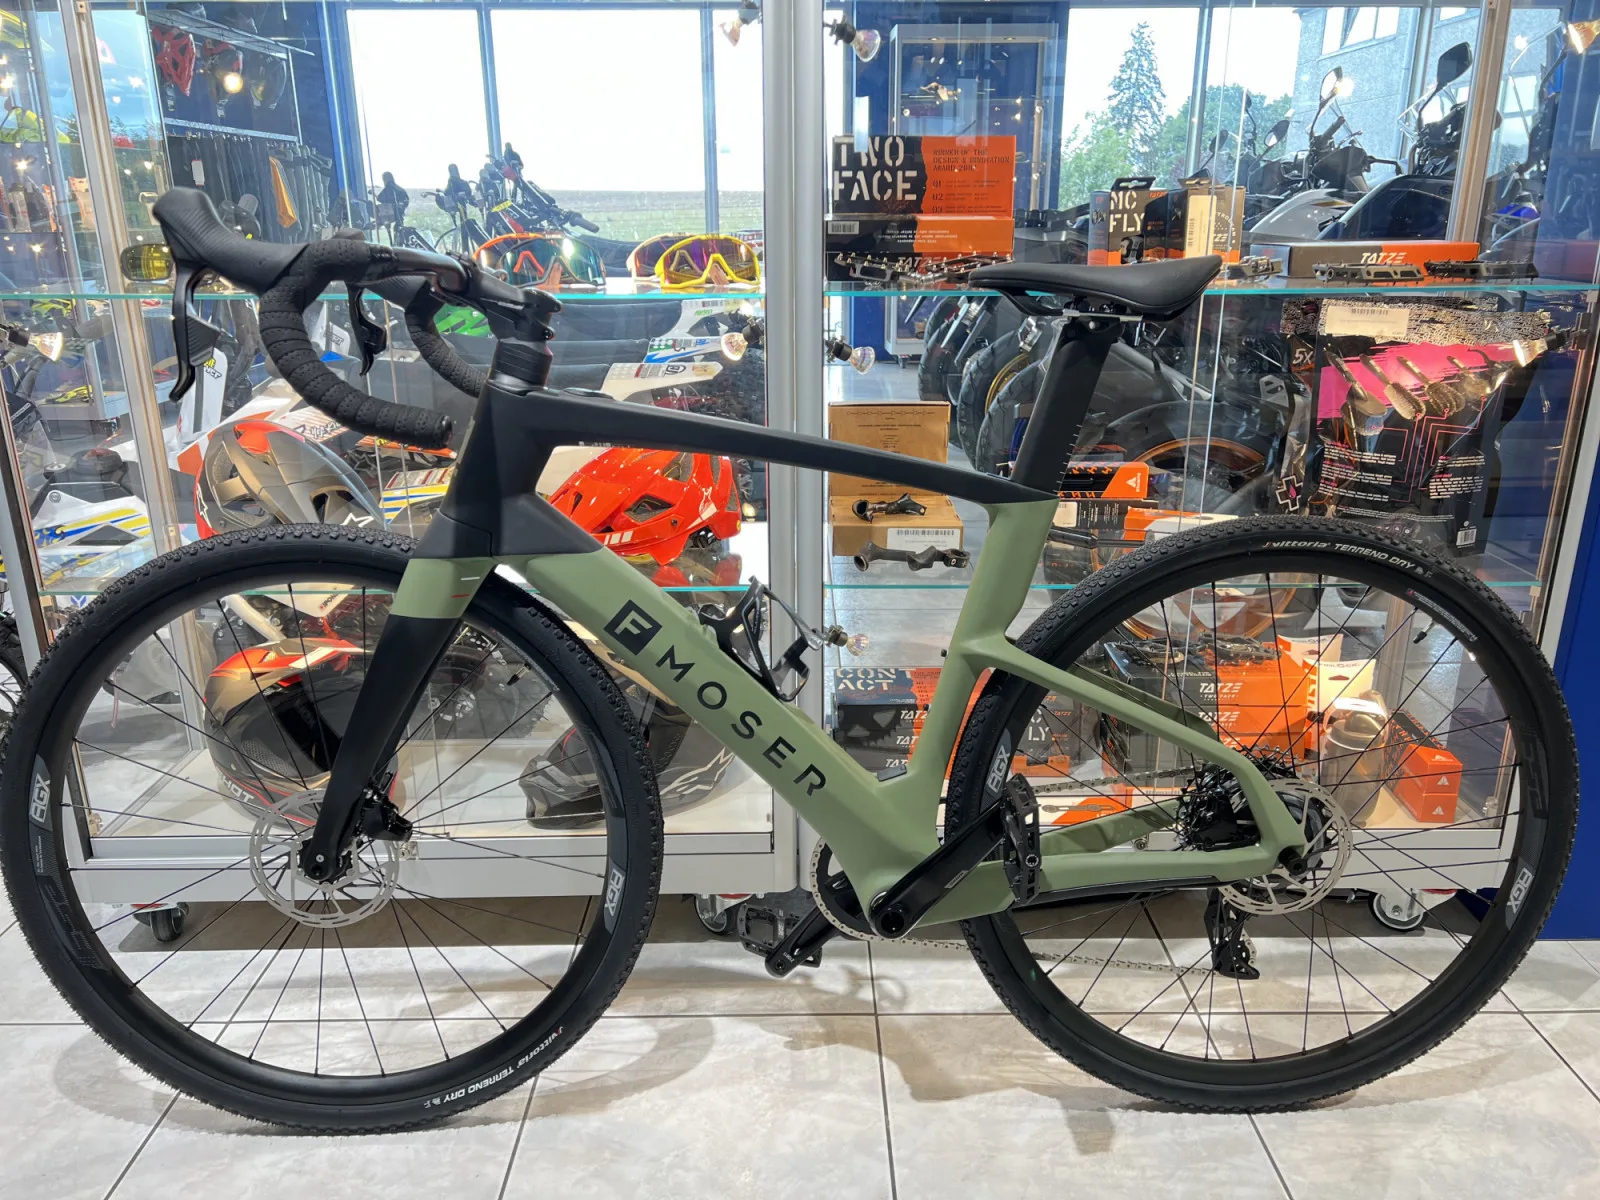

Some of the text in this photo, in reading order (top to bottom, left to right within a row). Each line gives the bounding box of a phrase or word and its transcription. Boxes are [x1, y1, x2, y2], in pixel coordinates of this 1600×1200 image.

[834, 136, 904, 167] TWO
[833, 170, 918, 201] FACE
[1110, 190, 1137, 210] MC
[1109, 212, 1144, 233] FLY
[1360, 252, 1408, 264] TATZE
[1334, 543, 1388, 561] TERRENO
[1388, 556, 1416, 570] DRY
[838, 679, 893, 690] ACT
[1199, 682, 1243, 693] TATZE
[655, 645, 827, 797] MOSER
[900, 710, 928, 719] TATZ
[896, 736, 919, 745] TAT
[1028, 726, 1050, 741] LY
[885, 759, 909, 767] TAT
[222, 773, 255, 803] HOT
[468, 1066, 514, 1095] TERRENO
[443, 1090, 466, 1104] DRY
